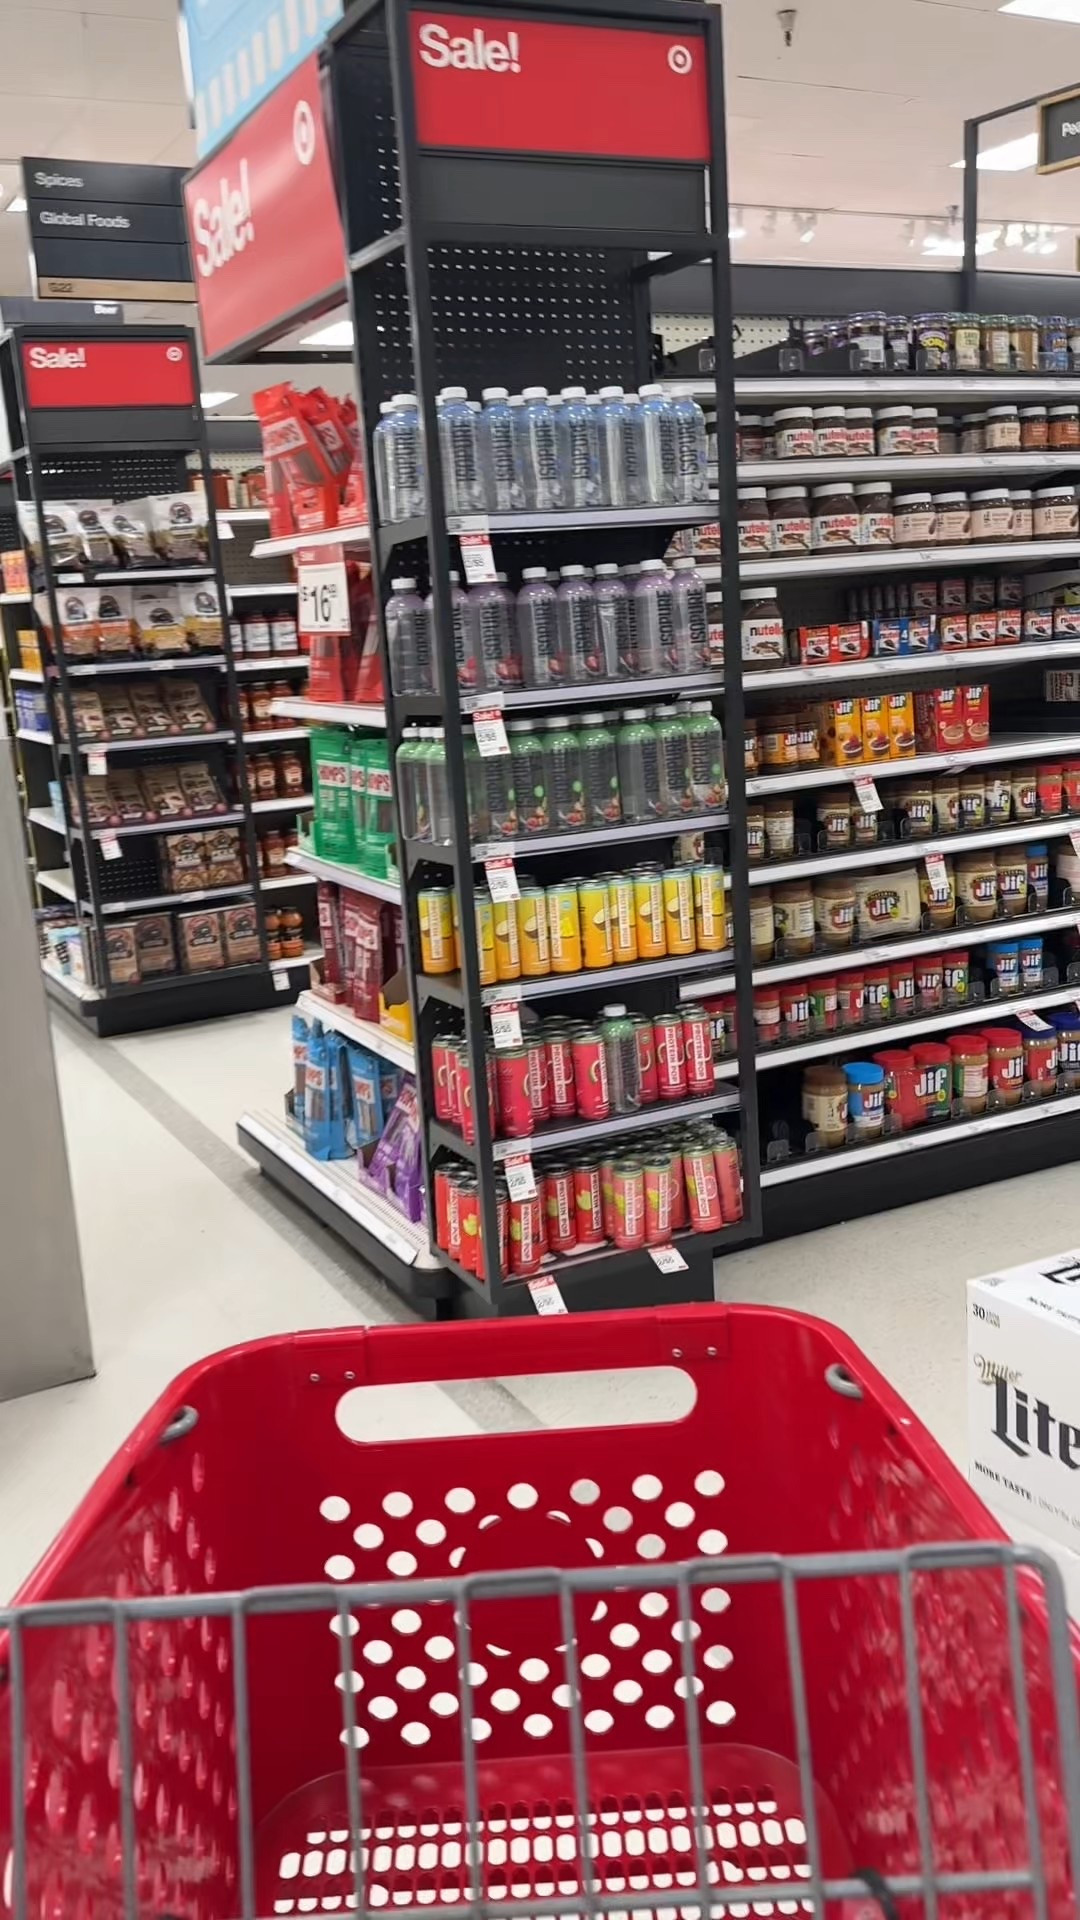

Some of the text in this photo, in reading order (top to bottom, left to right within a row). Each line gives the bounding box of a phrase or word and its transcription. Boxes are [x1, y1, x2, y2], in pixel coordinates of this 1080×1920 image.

[419, 23, 521, 73] Sale!
[34, 172, 84, 188] Spices
[39, 211, 131, 229] Global Foods
[192, 158, 255, 277] Sale!
[30, 347, 86, 368] Sale!
[677, 416, 699, 476] ISOPURE
[820, 516, 857, 529] nutella
[657, 590, 674, 647] ISOPURE
[687, 588, 706, 644] ISOPURE
[901, 629, 908, 639] 4
[890, 695, 906, 708] Jif
[938, 689, 954, 702] Jif
[966, 687, 982, 699] Jif
[837, 700, 853, 715] Jif
[865, 699, 880, 712] Jif
[798, 729, 815, 743] Jif
[909, 804, 930, 818] Jif
[1001, 873, 1024, 891] Jif
[930, 888, 947, 902] Jif
[871, 897, 895, 917] Jif
[997, 959, 1016, 972] Jif
[1022, 953, 1041, 966] Jif
[918, 973, 941, 989] Jif
[944, 967, 964, 987] if
[711, 1018, 725, 1041] if
[667, 1028, 678, 1082] PROTEIN POP
[694, 1024, 706, 1078] PROTEIN POP
[554, 1046, 566, 1101] PROTEIN POP
[915, 1068, 947, 1097] Jif
[864, 1091, 884, 1109] Jif
[592, 1174, 600, 1210] PROTEIN
[694, 1160, 708, 1214] PROTEIN POP
[559, 1180, 569, 1234] PROTEIN POP
[973, 1303, 985, 1320] 30
[973, 1353, 1022, 1385] Miller
[991, 1374, 1080, 1470] Lite
[975, 1461, 1001, 1483] MORE
[1002, 1476, 1032, 1502] TASTE
